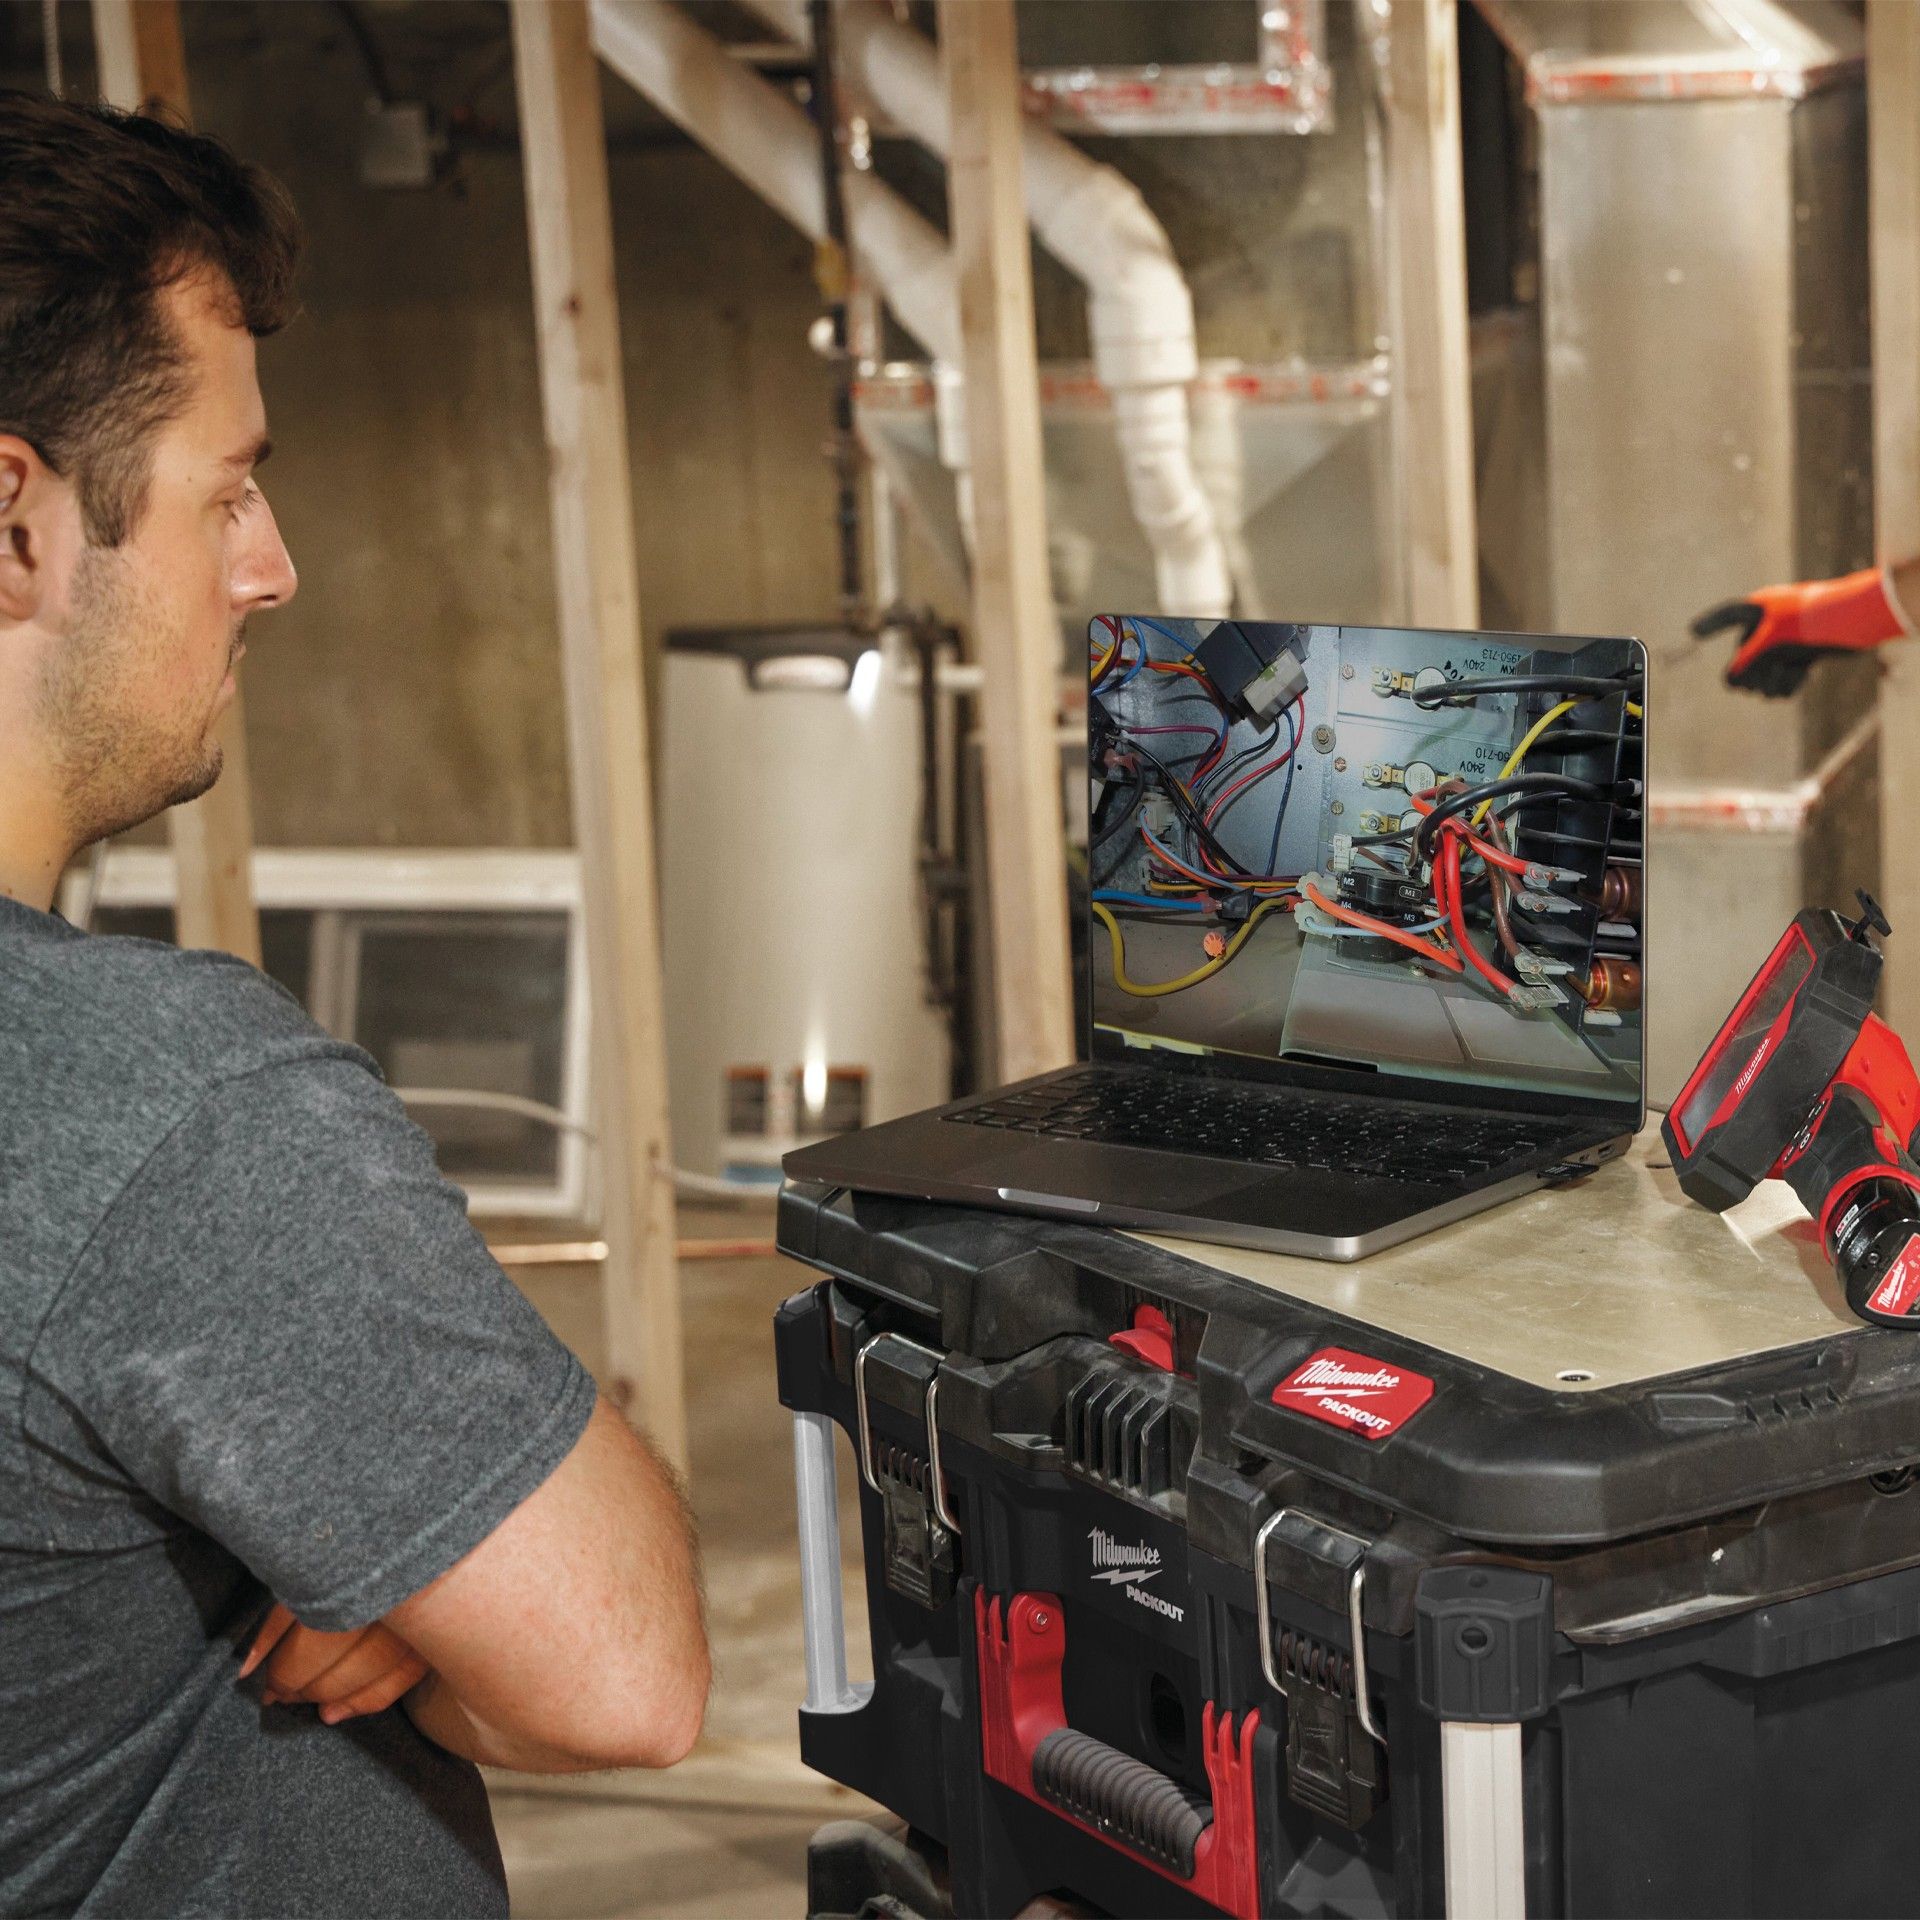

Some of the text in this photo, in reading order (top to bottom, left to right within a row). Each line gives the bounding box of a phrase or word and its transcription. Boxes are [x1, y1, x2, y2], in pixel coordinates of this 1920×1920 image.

[1463, 659, 1486, 672] 240V
[1459, 760, 1486, 774] 240V
[1343, 876, 1355, 886] M2
[1404, 888, 1417, 898] M1
[1341, 900, 1352, 909] M4
[1403, 913, 1416, 922] M3
[1735, 1037, 1770, 1095] Milwaukee
[1294, 1359, 1399, 1388] Milwaukee
[1317, 1397, 1392, 1431] PACKOUT
[1087, 1526, 1161, 1567] Milwaukee
[1126, 1584, 1184, 1622] PACKOUT
